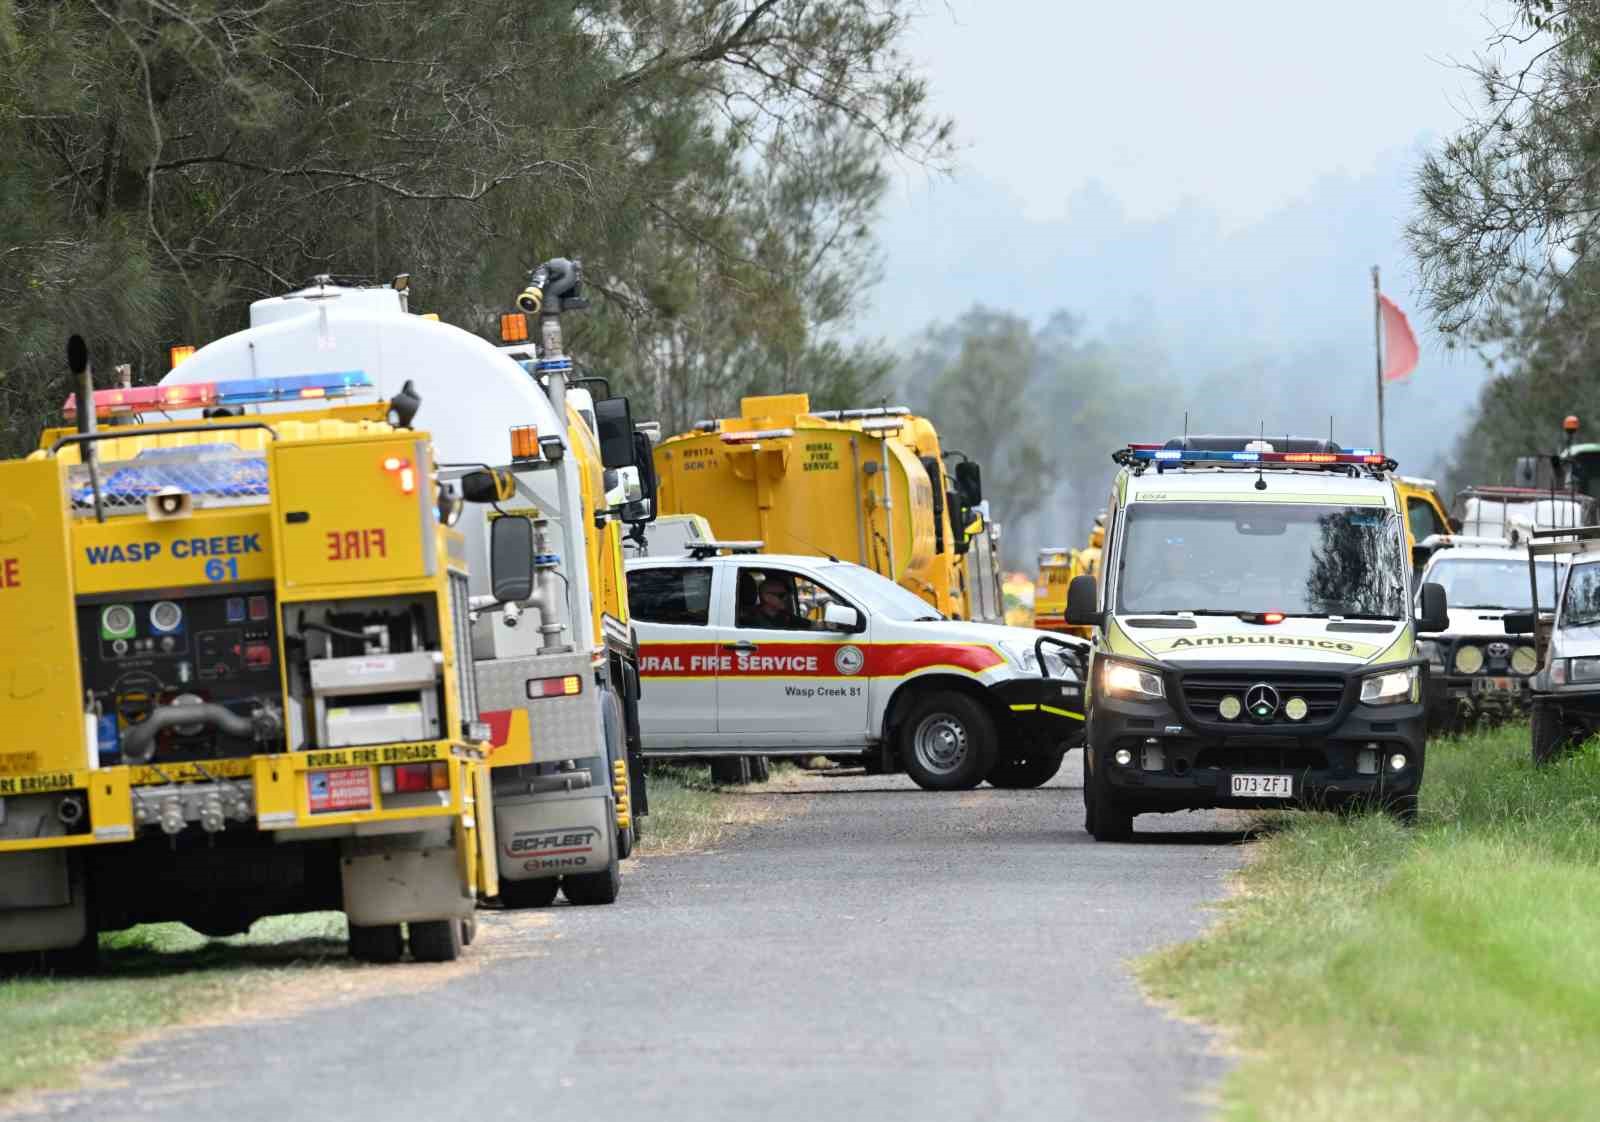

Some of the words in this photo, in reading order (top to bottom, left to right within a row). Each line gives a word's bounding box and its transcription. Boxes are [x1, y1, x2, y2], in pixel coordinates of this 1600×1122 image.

[805, 442, 833, 452] RURAL
[810, 452, 830, 461] FIRE
[802, 461, 839, 472] SERVICE
[85, 545, 161, 566] WASP
[171, 533, 262, 559] CREEK
[205, 557, 240, 582] 61
[1170, 635, 1354, 651] Ambulance
[690, 656, 732, 671] FIRE
[737, 655, 818, 671] SERVICE
[785, 686, 814, 698] Wasp
[817, 686, 847, 697] Creek
[849, 687, 862, 697] 81
[306, 751, 348, 766] RURAL
[352, 749, 378, 764] FIRE
[383, 744, 438, 762] BRIGADE
[20, 774, 74, 790] BRIGADE
[511, 832, 594, 850] SCI-FLEET
[541, 856, 587, 868] HINO
